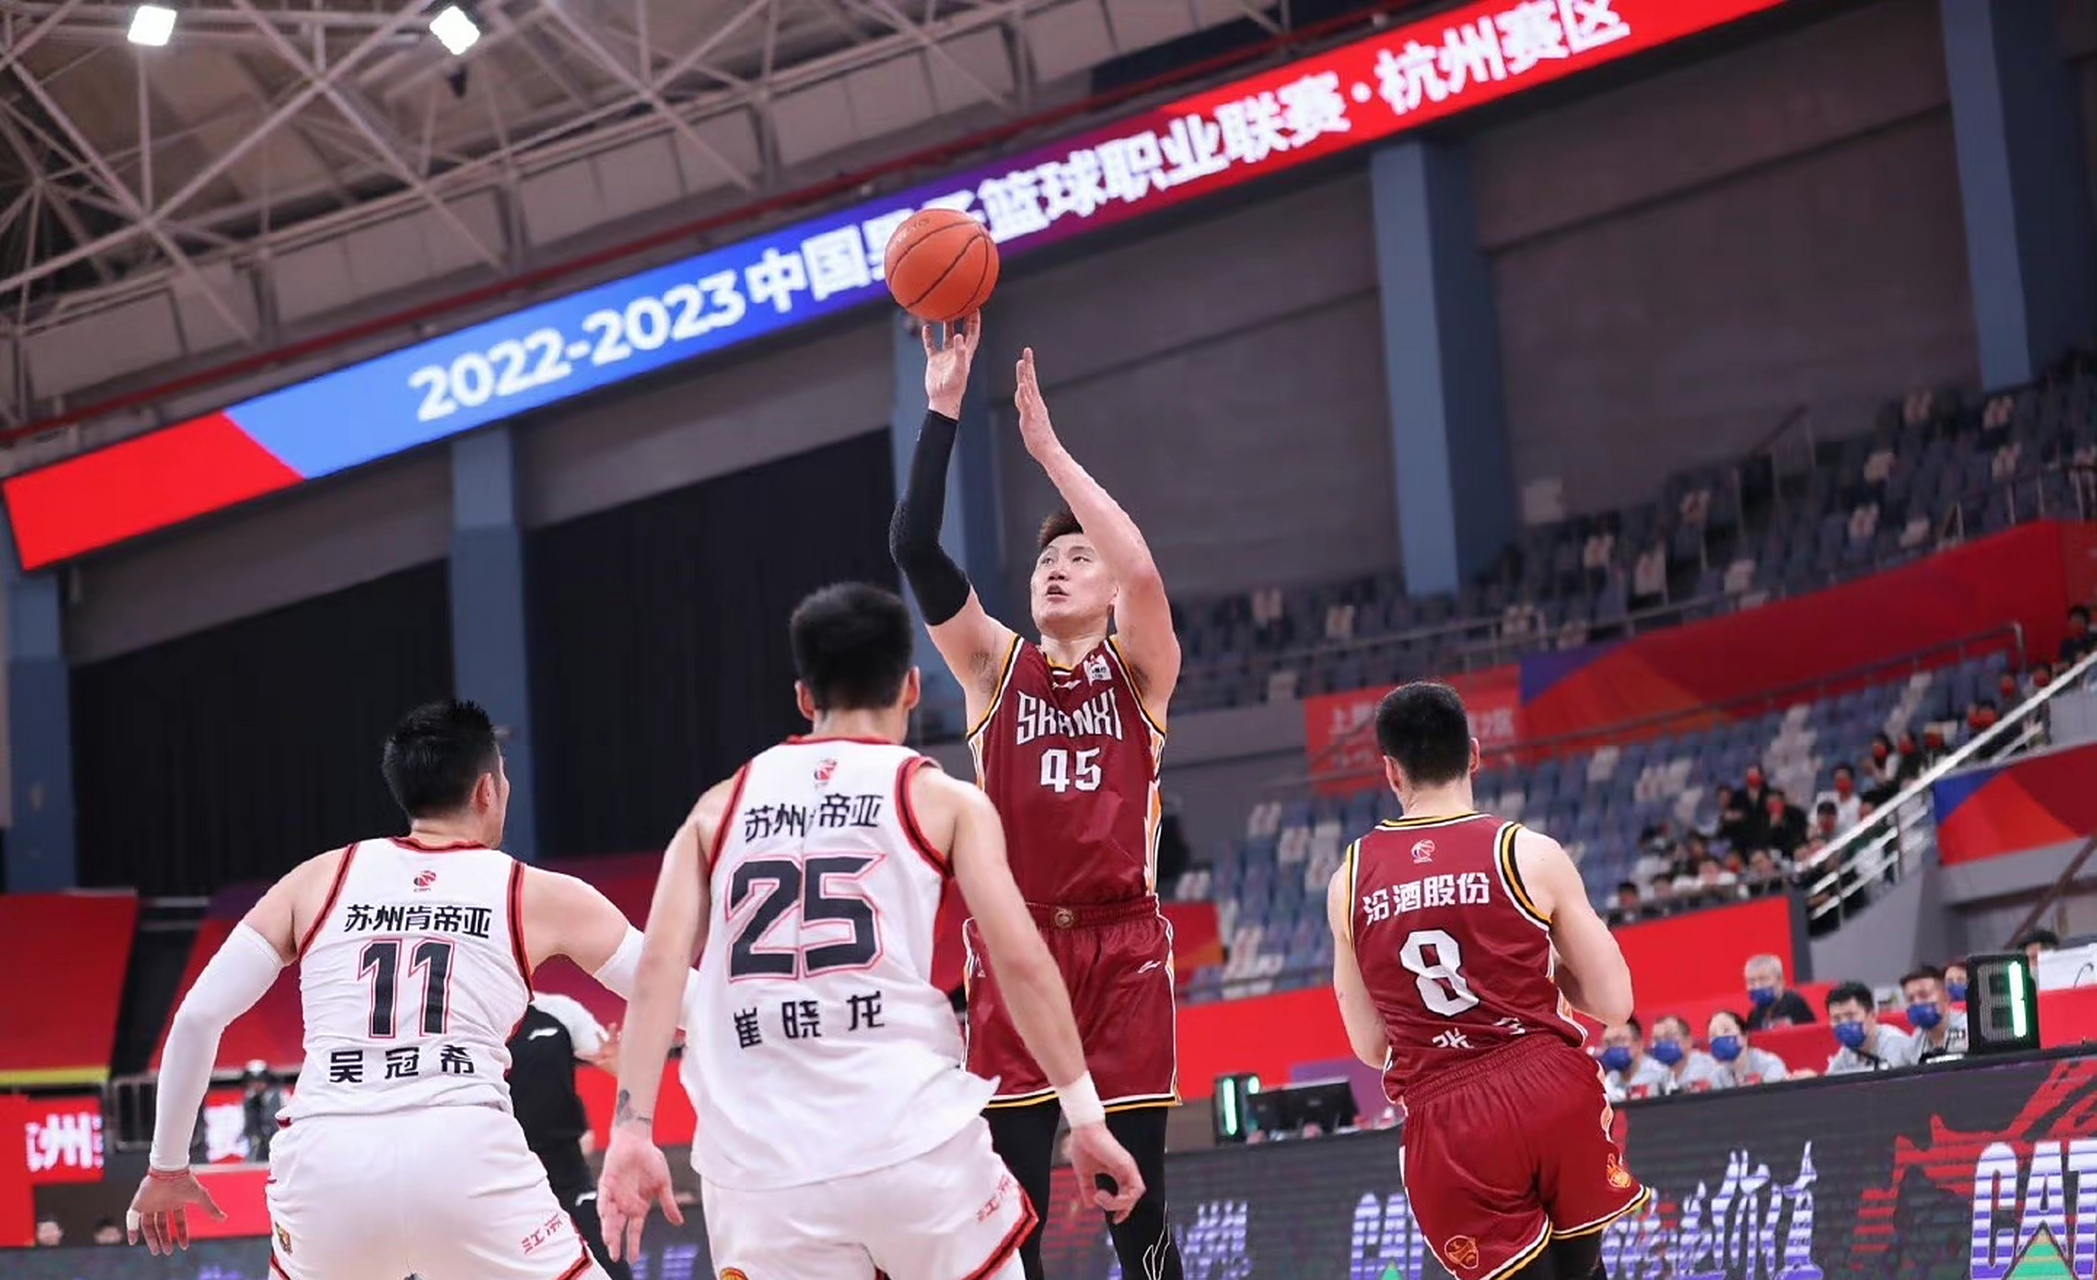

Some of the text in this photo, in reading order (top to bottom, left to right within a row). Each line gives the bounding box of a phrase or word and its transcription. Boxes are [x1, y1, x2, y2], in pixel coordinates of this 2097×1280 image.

[408, 268, 746, 422] 2022-2023
[1016, 687, 1123, 745] SHANXI
[1040, 747, 1102, 794] 45
[744, 793, 884, 843] 苏州帝亚
[343, 903, 492, 941] 苏州肯帝亚
[728, 852, 886, 984] 25
[1363, 871, 1491, 925] 汾酒股份
[358, 938, 456, 1039] 11
[1399, 928, 1481, 1018] 8
[328, 1045, 476, 1084] 吴冠希
